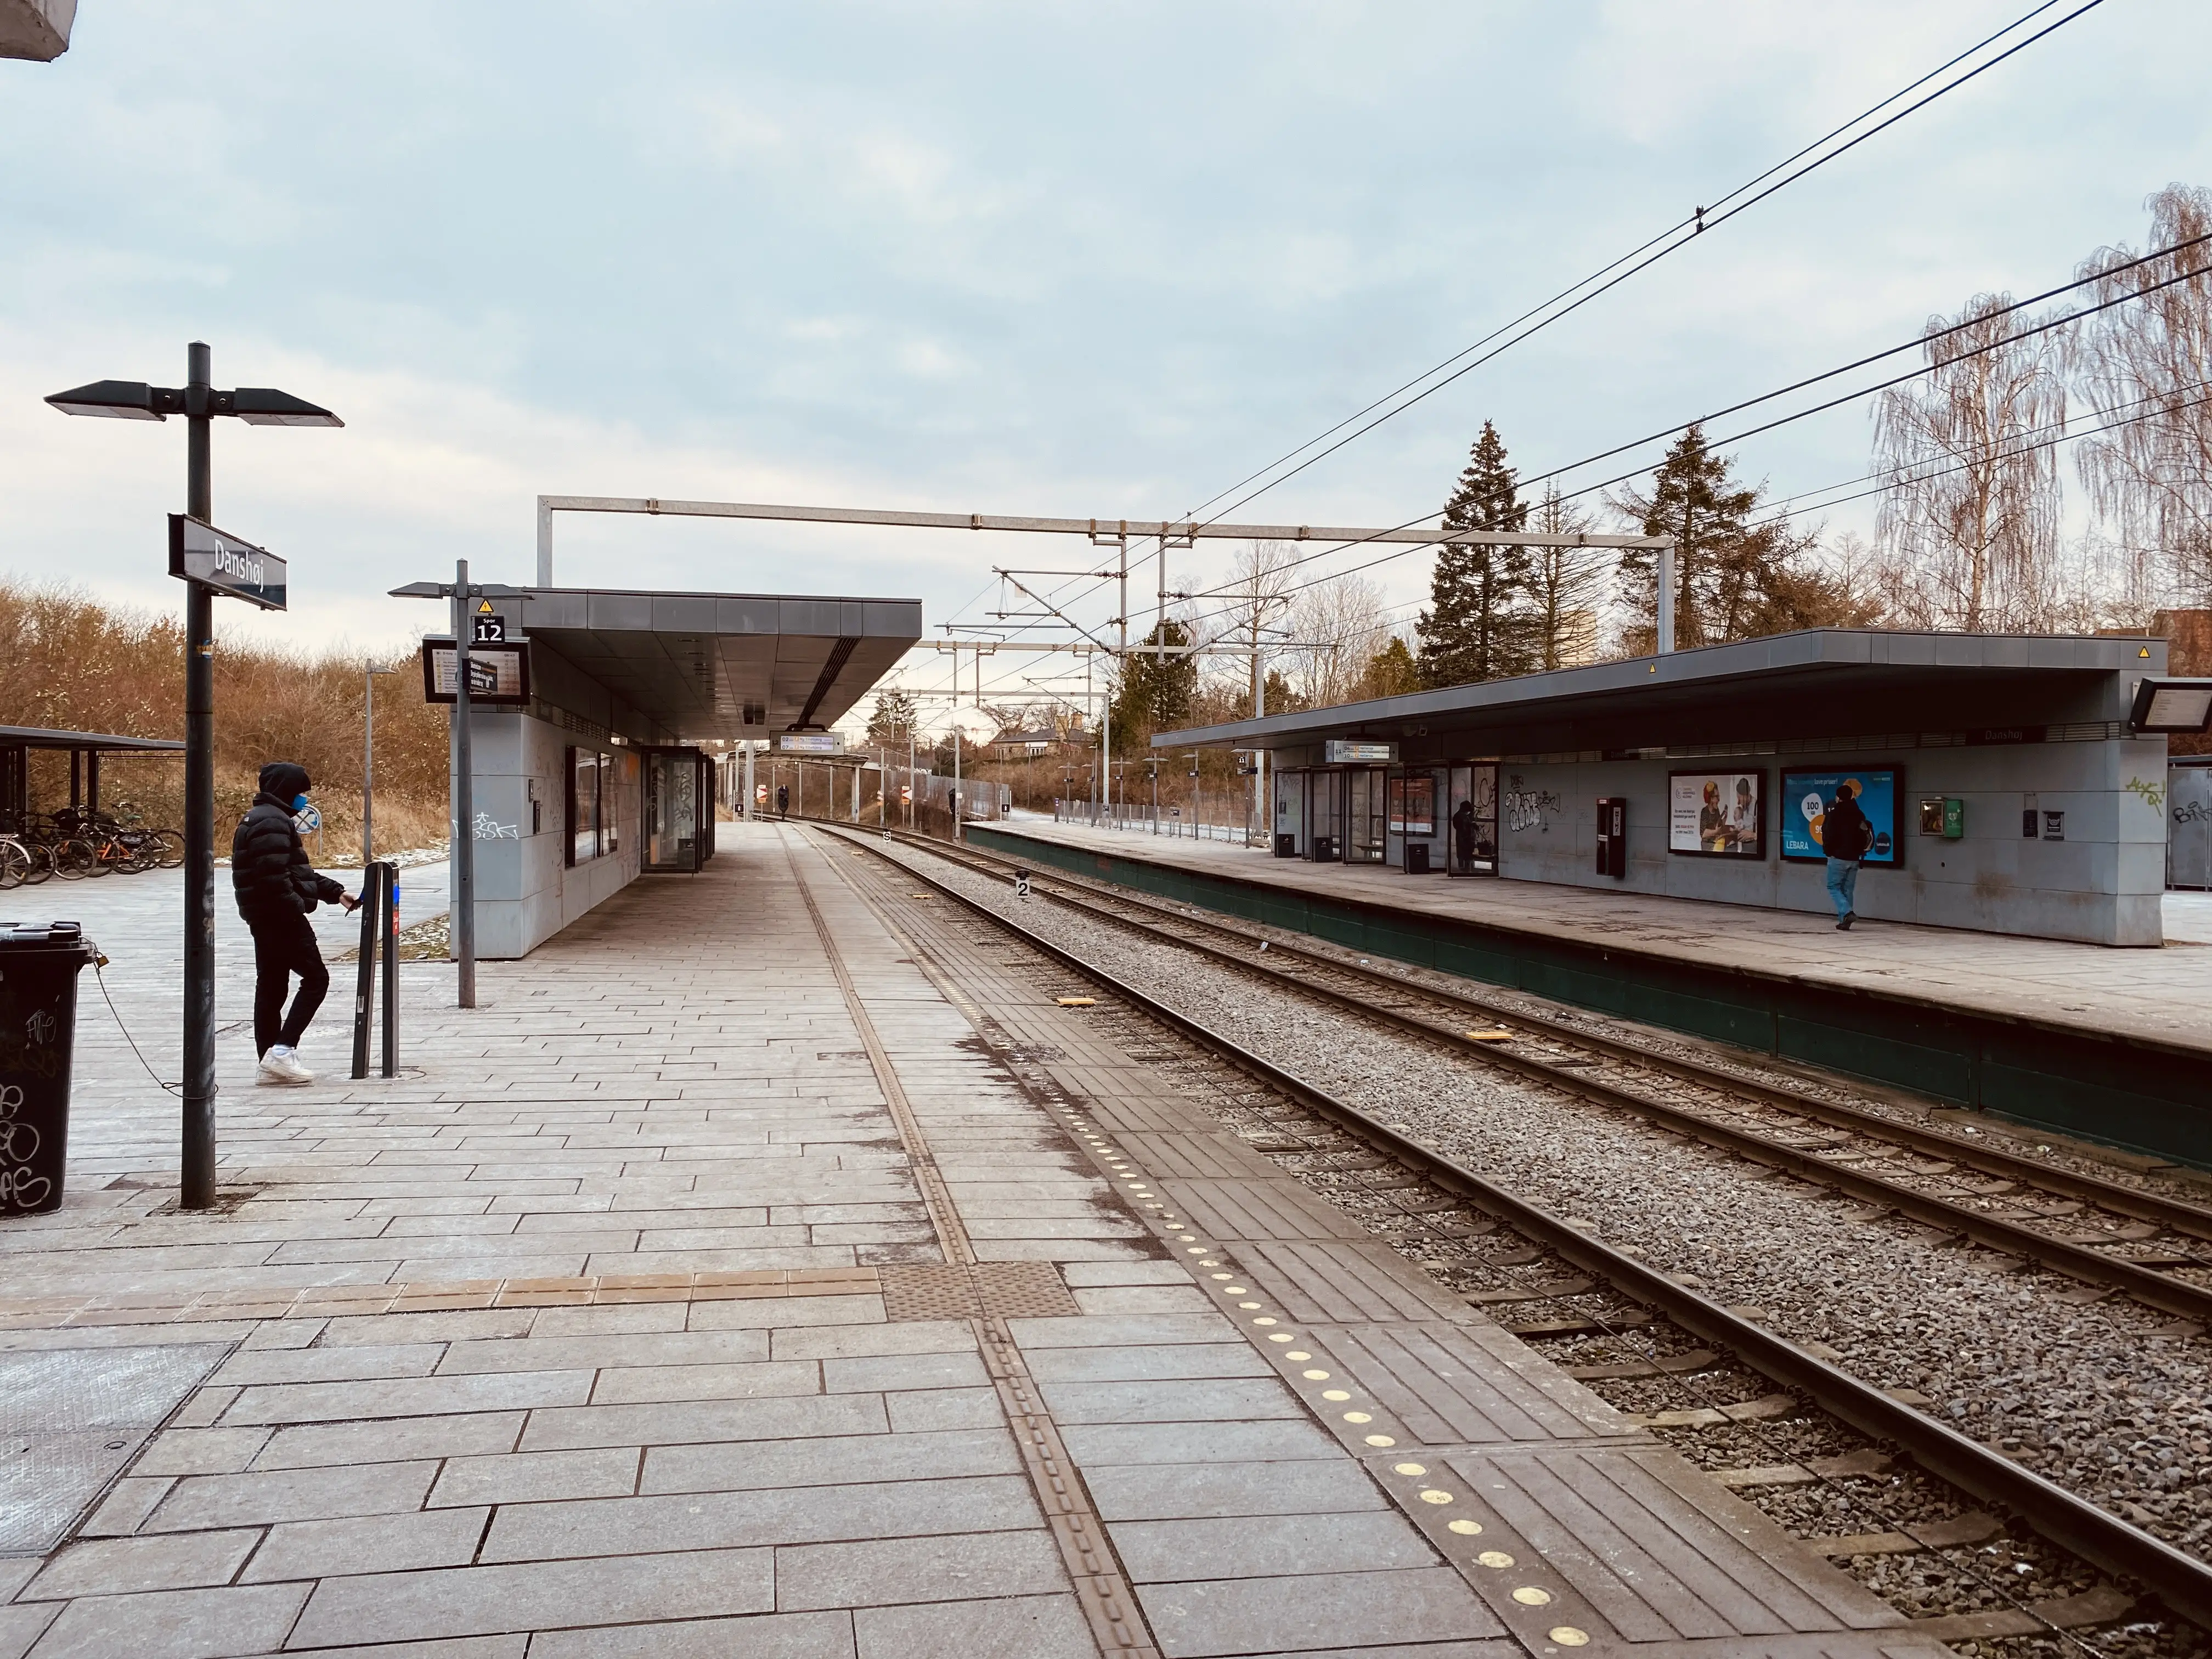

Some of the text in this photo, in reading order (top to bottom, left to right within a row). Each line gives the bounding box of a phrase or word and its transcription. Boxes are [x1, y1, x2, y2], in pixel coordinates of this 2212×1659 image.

[215, 539, 264, 594] Danshøj
[478, 625, 502, 641] 12
[1985, 729, 2023, 741] Danshøj
[1807, 802, 1819, 810] 100
[1786, 840, 1809, 850] LEBARA
[1018, 882, 1028, 896] 2
